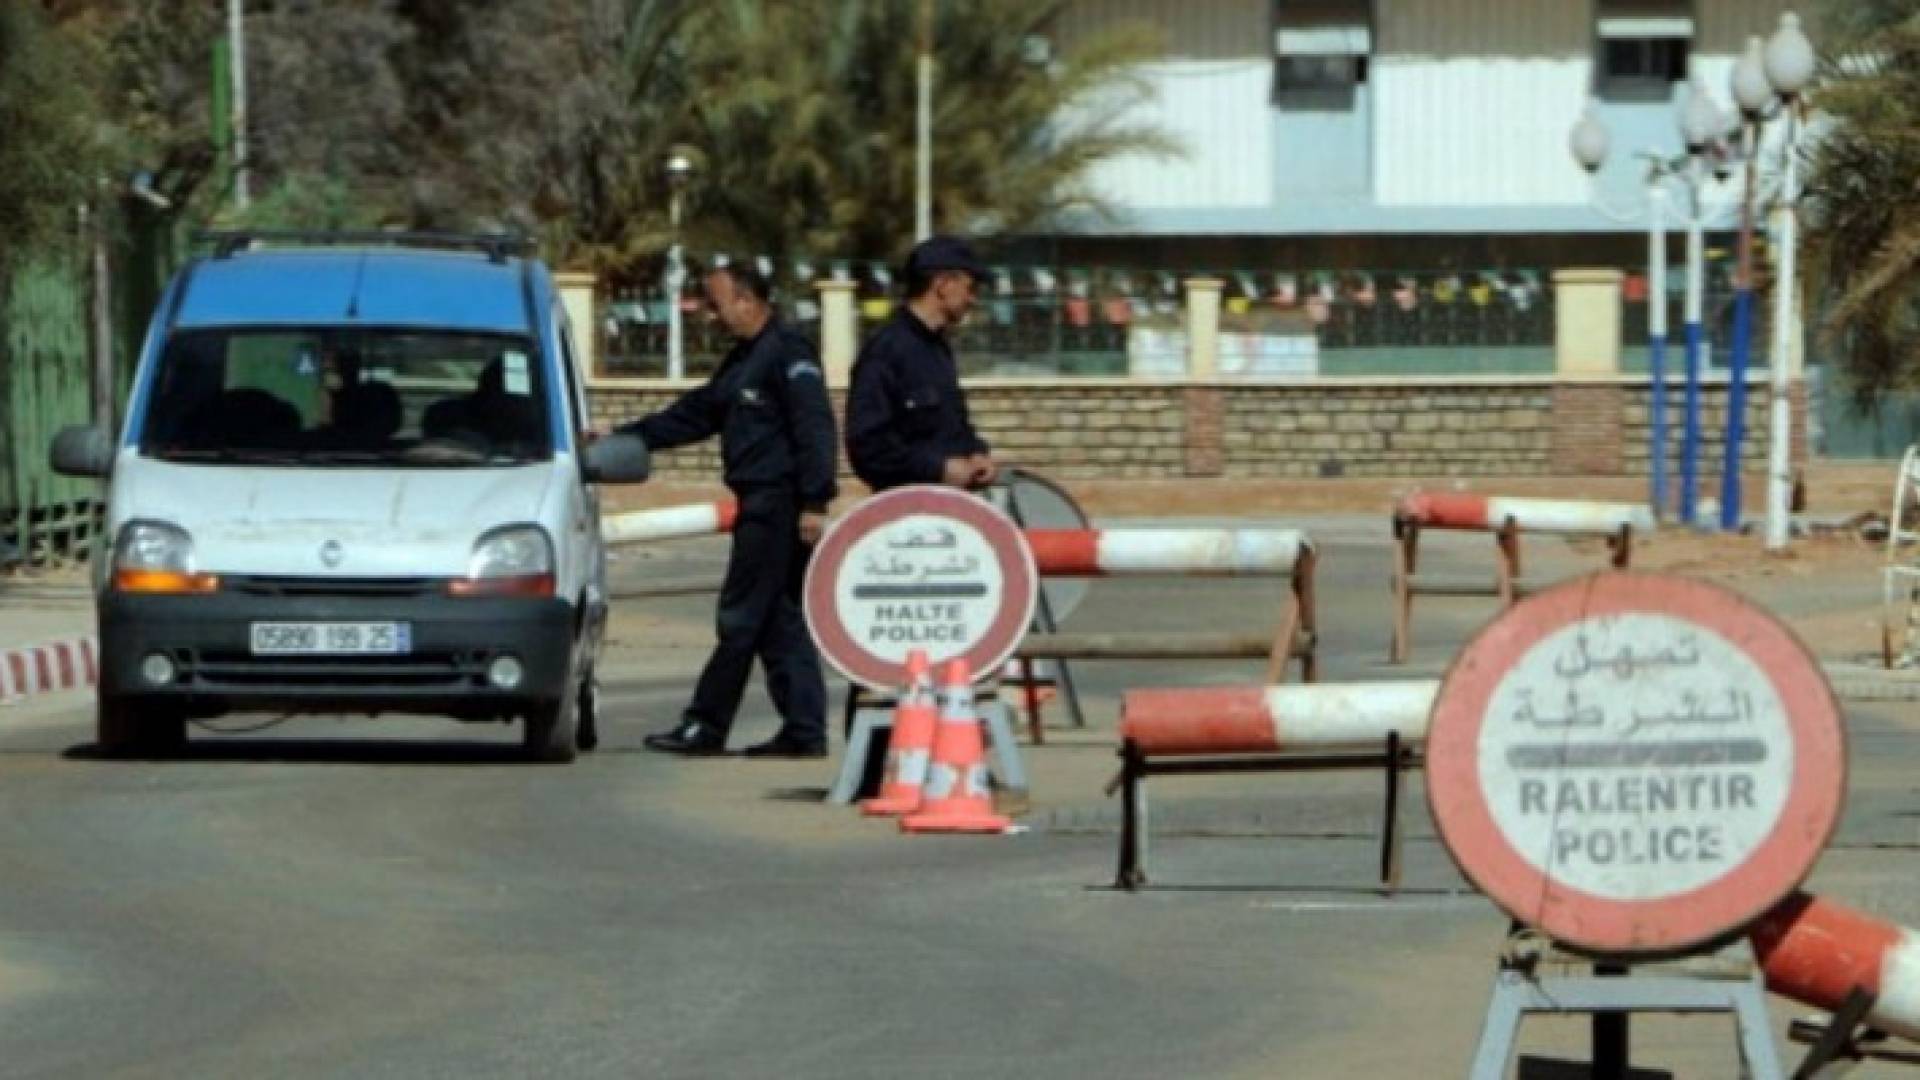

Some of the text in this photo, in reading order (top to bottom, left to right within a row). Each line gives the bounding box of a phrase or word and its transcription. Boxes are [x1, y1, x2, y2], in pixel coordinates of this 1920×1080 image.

[875, 604, 962, 621] HALTE
[367, 625, 393, 648] 25
[869, 624, 967, 642] POLICE
[1512, 687, 1755, 738] الشرطة
[1519, 772, 1756, 815] RALENTIR
[1556, 825, 1724, 865] POLICE
